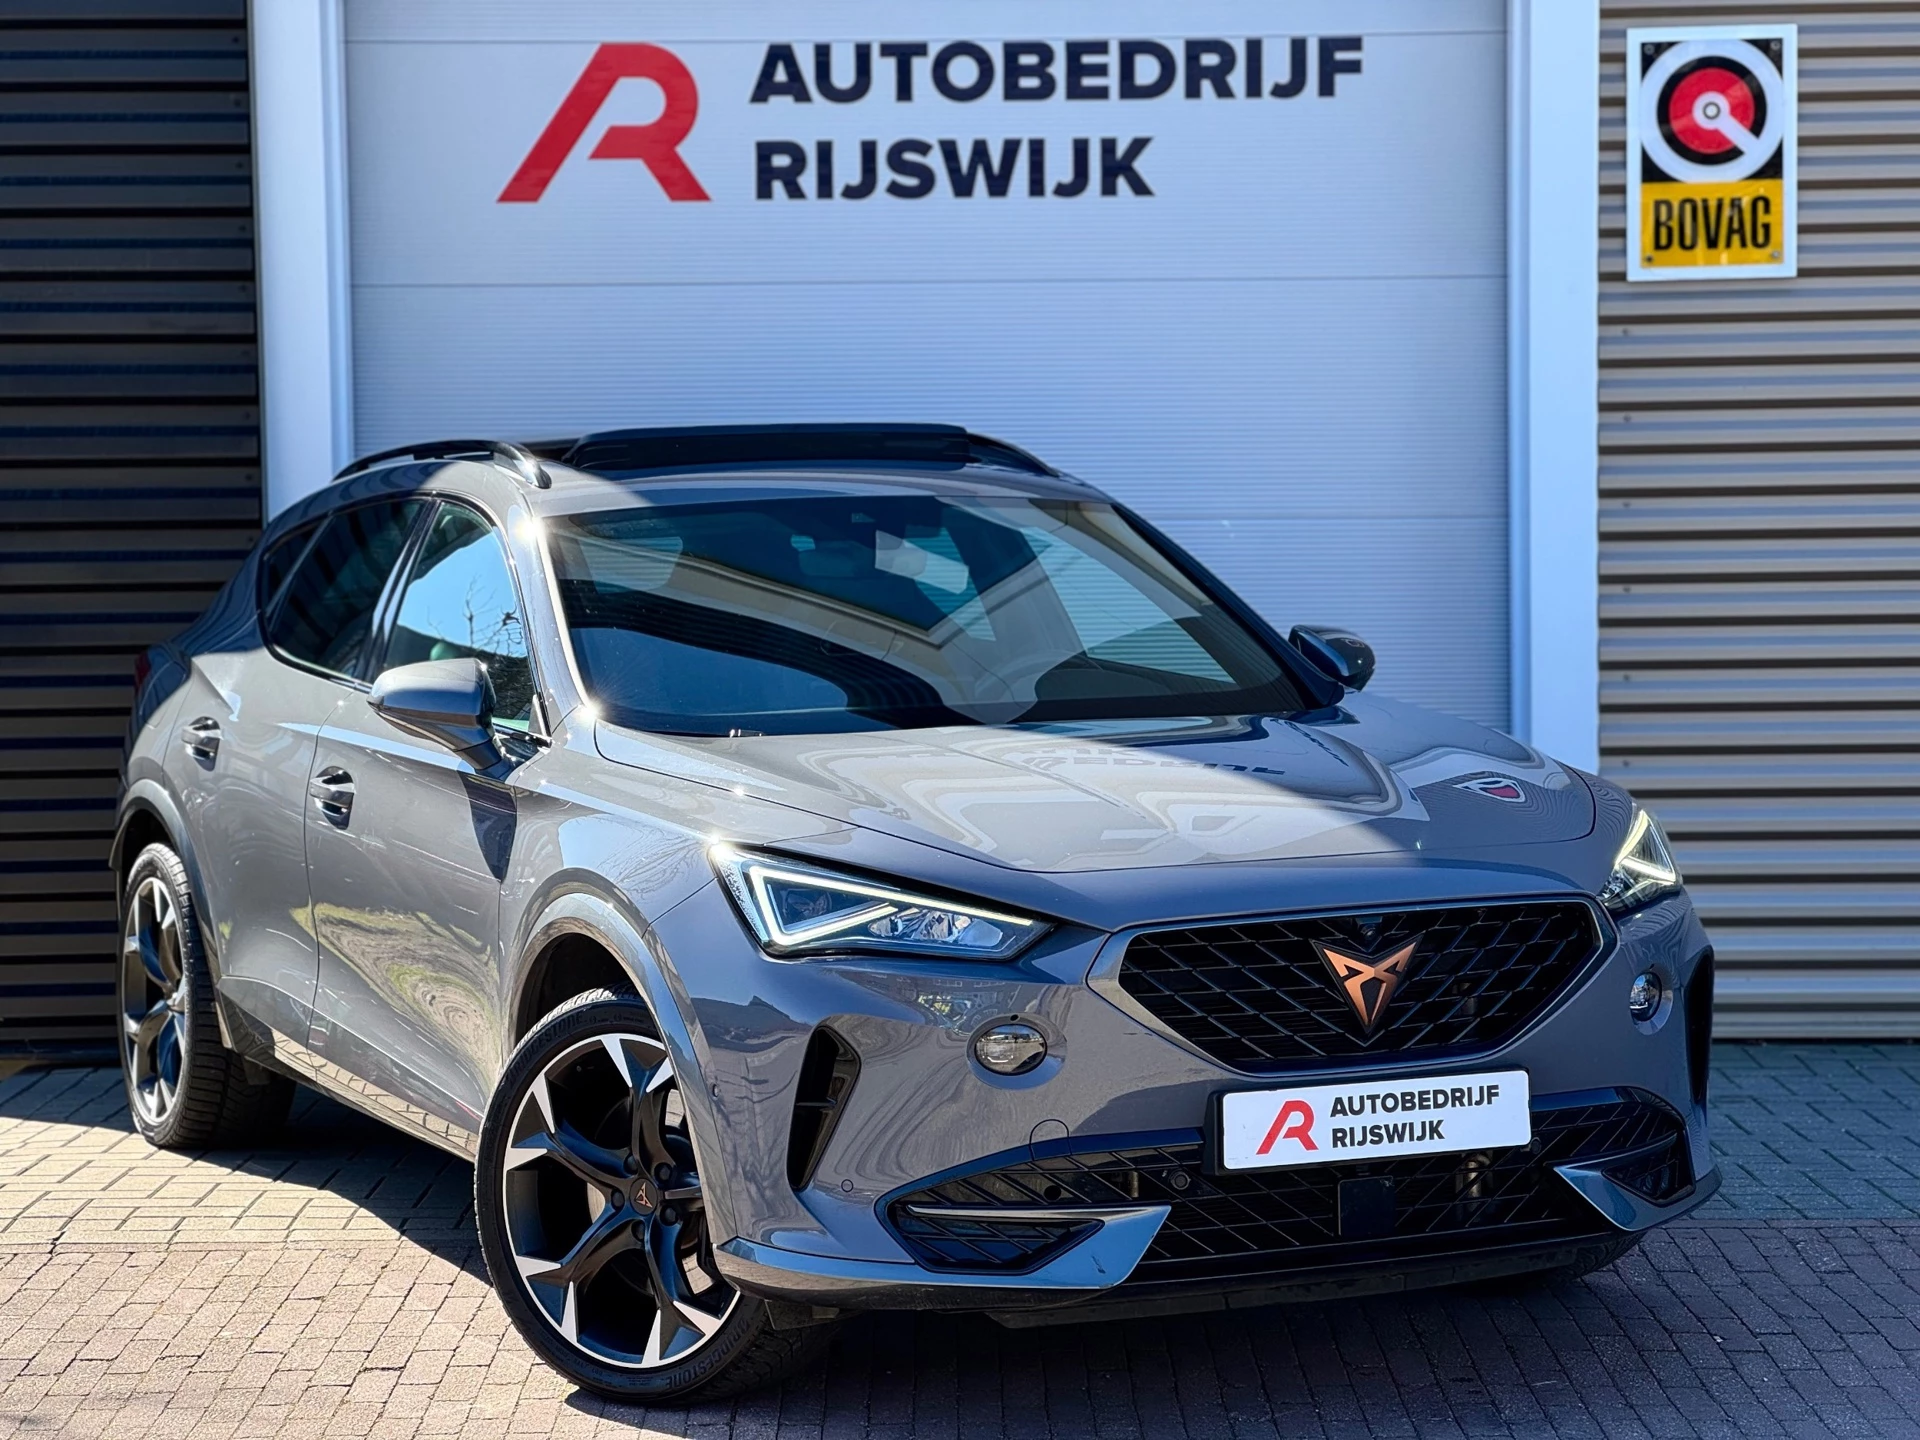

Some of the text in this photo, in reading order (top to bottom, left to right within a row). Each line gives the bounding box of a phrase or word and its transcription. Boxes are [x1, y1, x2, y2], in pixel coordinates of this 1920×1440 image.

[750, 37, 1363, 104] AUTOBEDRIJF
[755, 137, 1154, 200] RIJSWIJK
[1653, 195, 1771, 251] BOVAG
[1330, 1084, 1500, 1117] AUTOBEDRIJF
[1331, 1119, 1445, 1148] RIJSWIJK
